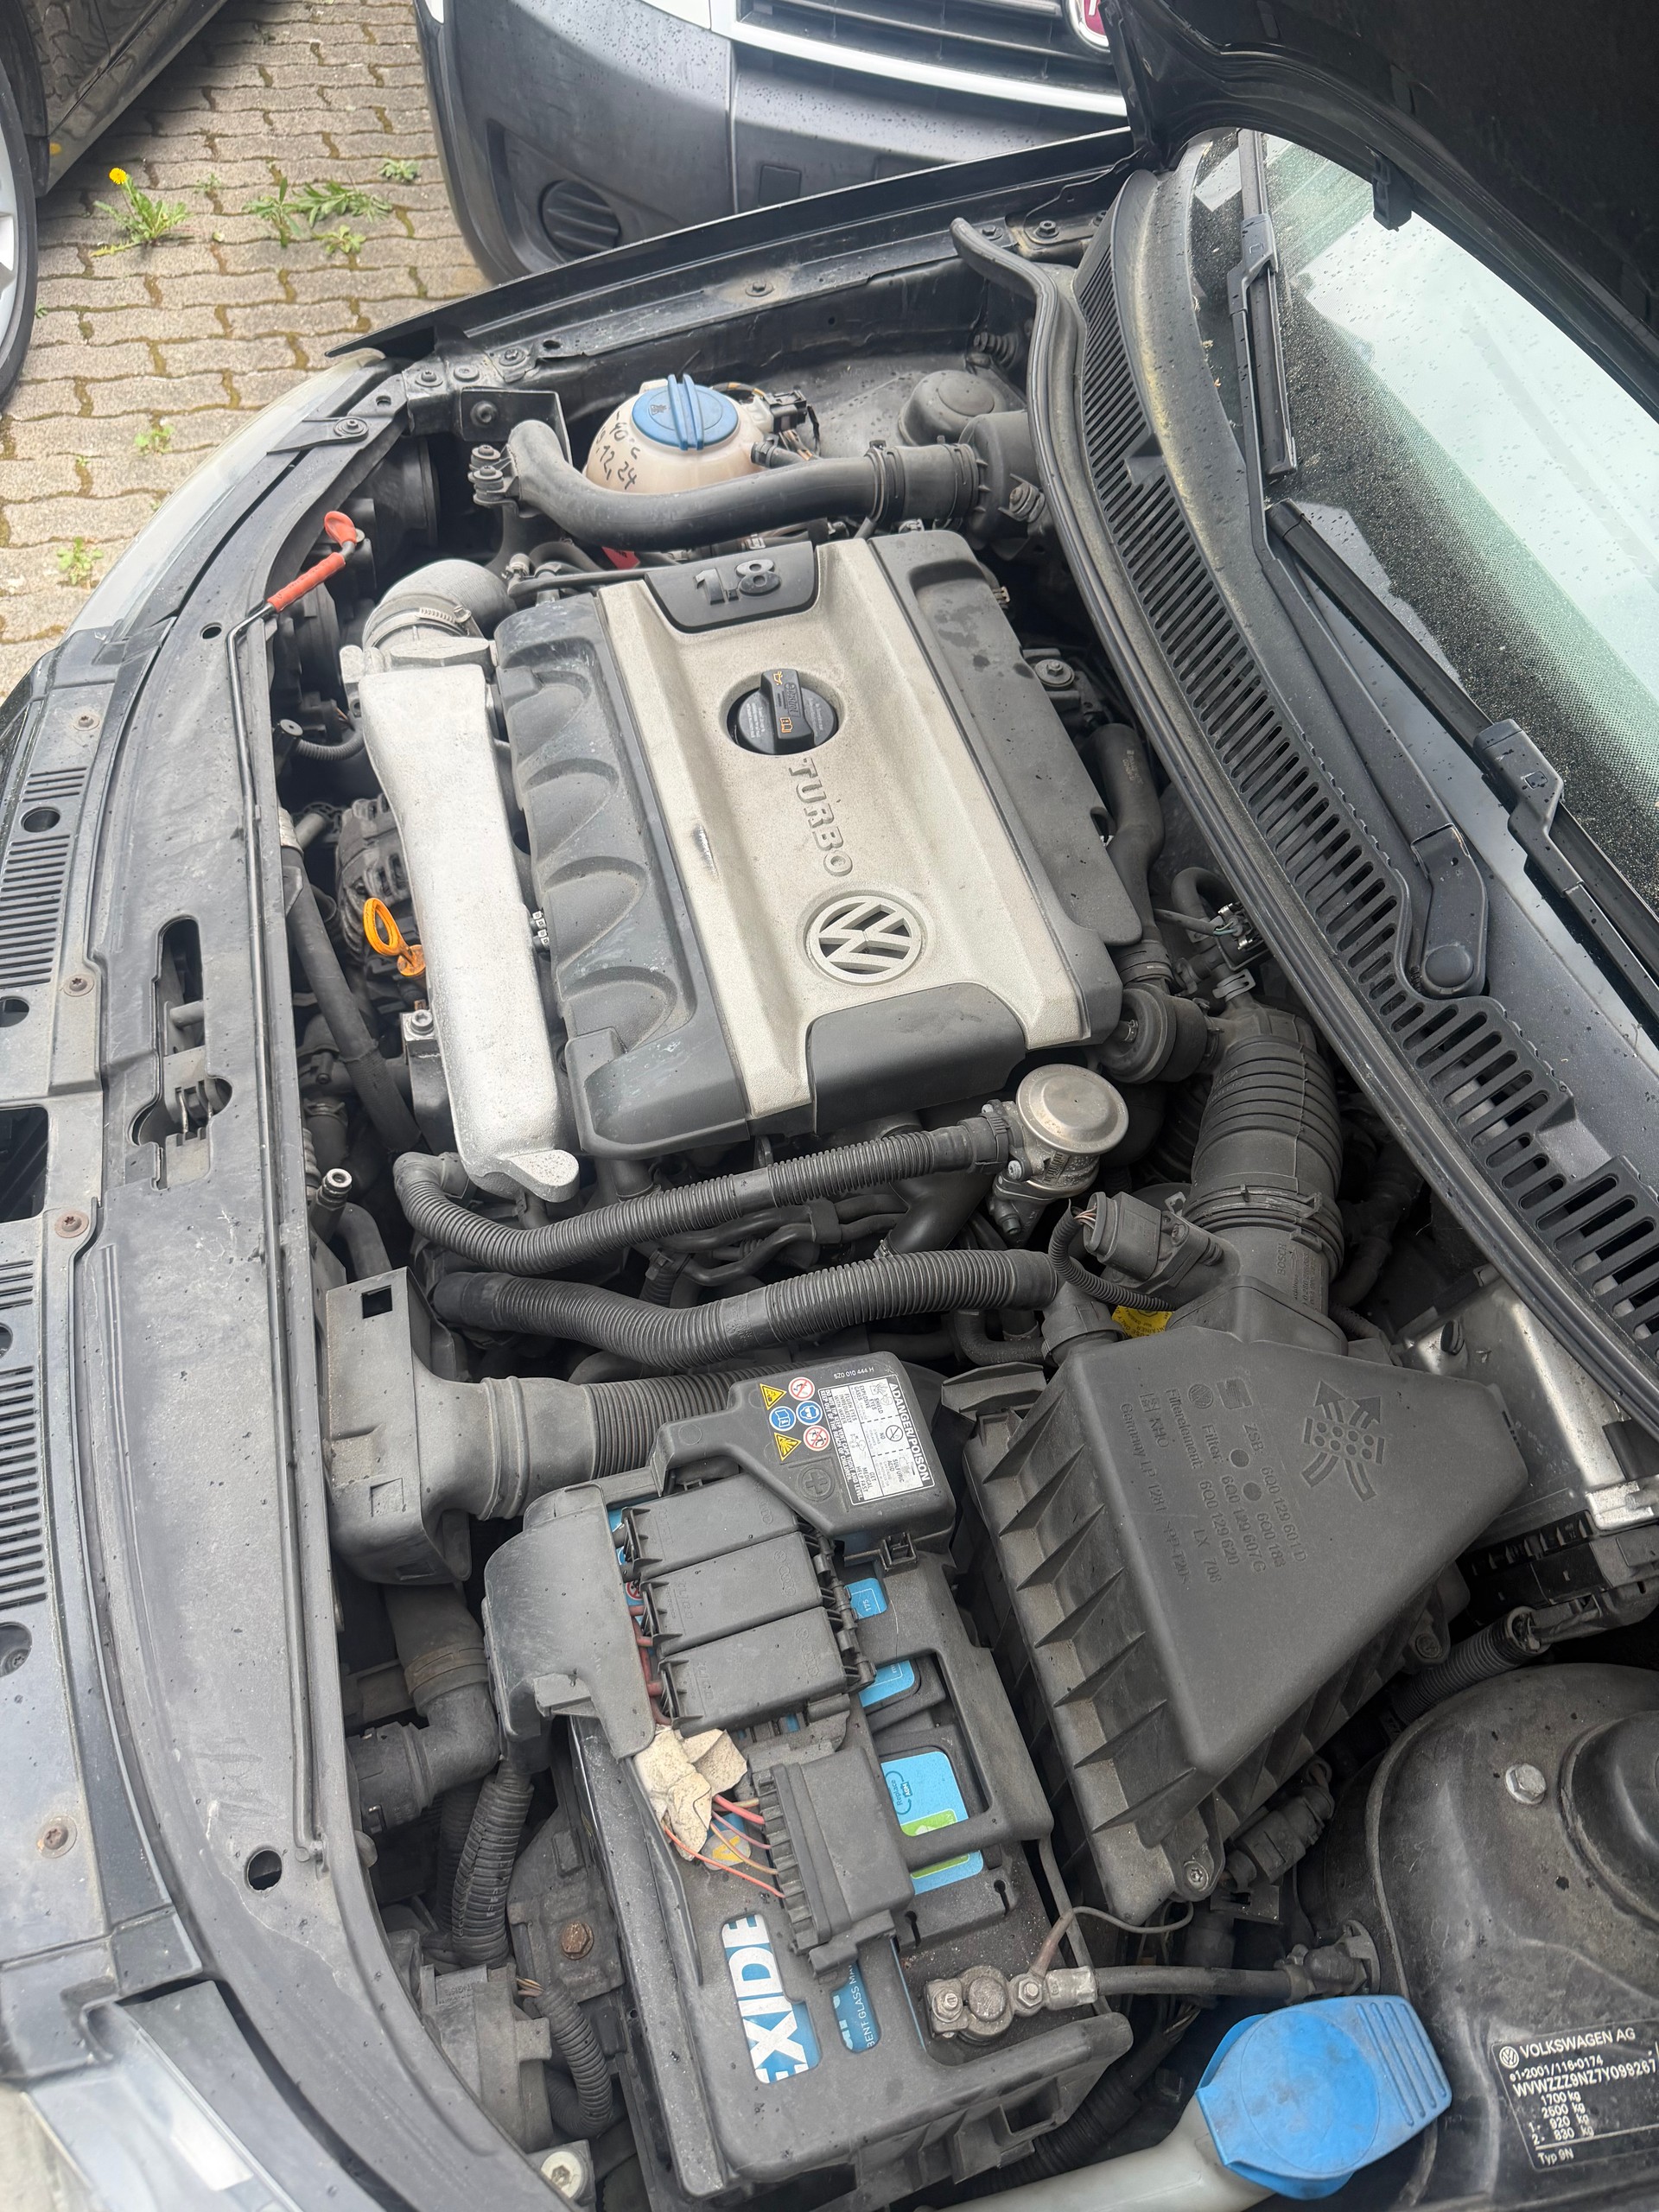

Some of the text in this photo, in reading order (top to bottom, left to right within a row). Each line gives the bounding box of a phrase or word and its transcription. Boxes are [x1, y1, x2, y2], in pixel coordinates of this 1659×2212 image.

[694, 559, 781, 605] 1.8
[788, 757, 853, 877] TURBO
[1276, 1243, 1286, 1275] BOSCH
[853, 1385, 862, 1401] GASES
[858, 1384, 870, 1408] EXPLOSIVE
[874, 1396, 883, 1414] SHIELD
[833, 1395, 847, 1424] WITH WATER
[843, 1393, 853, 1408] FLUSH
[849, 1408, 857, 1421] EYES
[891, 1389, 930, 1482] DANGER/POISON
[892, 1459, 904, 1483] SULFURIC
[1118, 1402, 1147, 1459] Germany
[1138, 1459, 1156, 1479] LP
[1147, 1482, 1167, 1513] 1281
[861, 1466, 873, 1489] MEDICAL
[1201, 1422, 1226, 1465] Filter:
[1219, 1473, 1241, 1504] 6Q0
[1232, 1507, 1251, 1532] 129
[1259, 1465, 1281, 1495] 6Q0
[1197, 1478, 1219, 1510] 6Q0
[1272, 1497, 1291, 1522] 129
[1210, 1510, 1230, 1538] 129
[1255, 1510, 1276, 1541] 6Q0
[1281, 1522, 1301, 1548] 601
[1219, 1536, 1240, 1567] 620
[1293, 1549, 1306, 1563] D
[862, 1599, 871, 1611] 175
[890, 1779, 902, 1805] Replace
[850, 1986, 867, 2018] GLASS
[1520, 2031, 1612, 2058] VOLKSWAGEN
[1614, 2026, 1636, 2042] AG
[1540, 2089, 1581, 2106] 1700 kg
[1571, 2101, 1586, 2113] kg
[1576, 2112, 1590, 2125] kg
[1580, 2124, 1594, 2136] kg
[1537, 2147, 1574, 2166] Typ 9N
